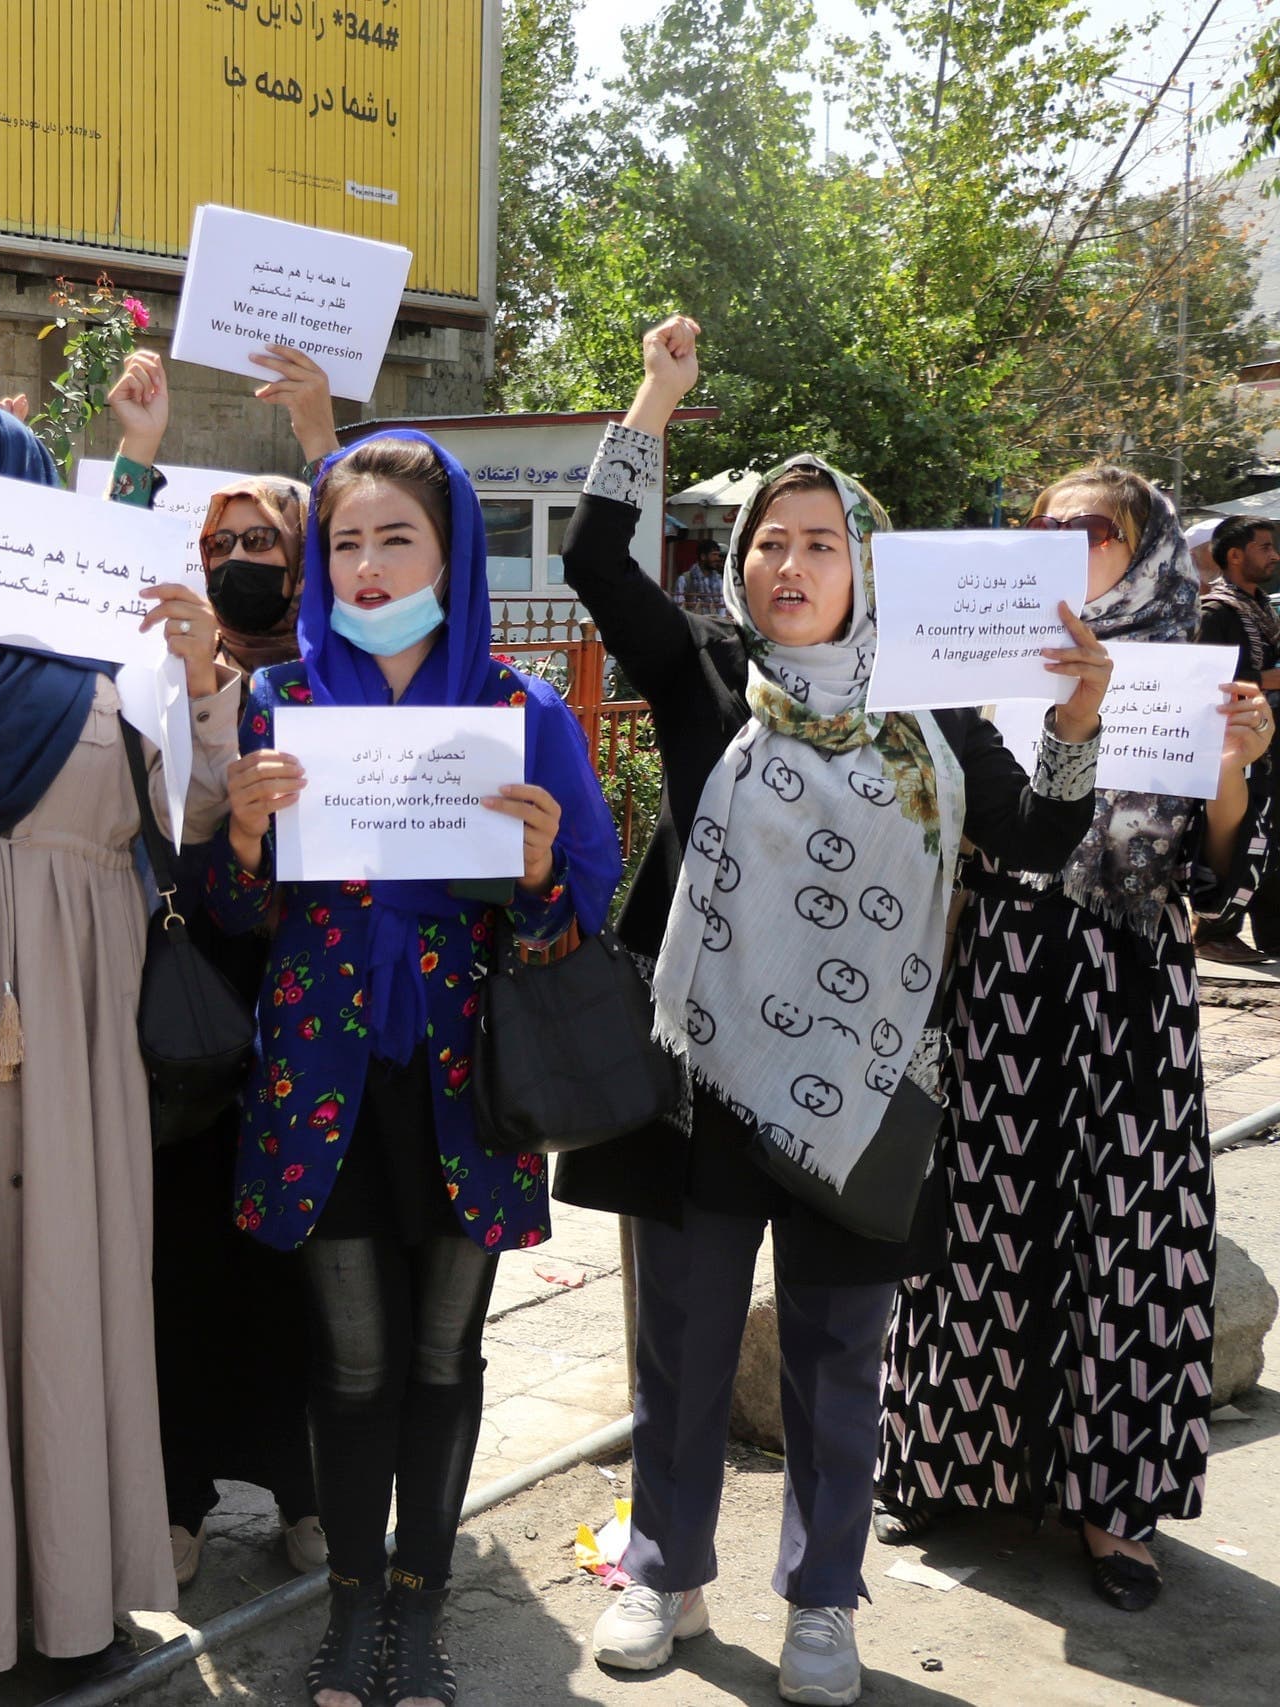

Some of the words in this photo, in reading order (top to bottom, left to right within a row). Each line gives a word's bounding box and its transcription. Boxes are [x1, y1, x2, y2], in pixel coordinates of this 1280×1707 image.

[255, 72, 303, 104] همه
[309, 88, 333, 118] در
[342, 86, 378, 123] شما
[386, 99, 397, 137] با
[253, 262, 283, 275] هستیم
[288, 268, 300, 280] هم
[306, 271, 314, 282] با
[318, 273, 336, 285] همه
[341, 277, 350, 288] ما
[249, 283, 291, 299] شکستیم
[295, 292, 314, 304] ستم
[320, 297, 326, 308] و
[328, 298, 346, 309] ظلم
[233, 300, 254, 315] We
[257, 307, 278, 320] are
[282, 310, 297, 323] all
[300, 315, 352, 336] together
[211, 319, 232, 334] We
[235, 324, 271, 342] broke
[274, 334, 295, 347] the
[299, 340, 363, 361] oppression
[477, 467, 519, 482] اعتماد
[527, 466, 559, 484] مورد
[43, 550, 65, 567] هم
[76, 552, 89, 575] با
[96, 559, 129, 579] همه
[140, 566, 157, 585] ما
[957, 575, 980, 589] زنان
[983, 577, 1007, 589] بدون
[1012, 575, 1037, 588] کشور
[55, 588, 90, 606] ستم
[1012, 598, 1040, 609] منطقه
[97, 600, 110, 613] و
[116, 600, 148, 618] ظلم
[953, 599, 976, 613] زبان
[979, 601, 992, 614] بی
[996, 599, 1008, 613] ای
[916, 624, 924, 635] A
[928, 625, 974, 639] country
[978, 623, 1025, 636] without
[932, 649, 941, 660] A
[944, 648, 1019, 661] languageless
[1152, 725, 1190, 739] Earth
[397, 751, 414, 763] کار
[428, 750, 466, 763] تحصیل
[1114, 745, 1129, 756] of
[1132, 746, 1158, 760] this
[1163, 750, 1194, 763] land
[390, 772, 417, 784] سوی
[421, 772, 433, 784] به
[437, 771, 461, 787] پیش
[324, 794, 479, 808] Education,work,freedo
[351, 818, 407, 830] Forward
[411, 819, 425, 830] to
[429, 817, 466, 830] abadi
